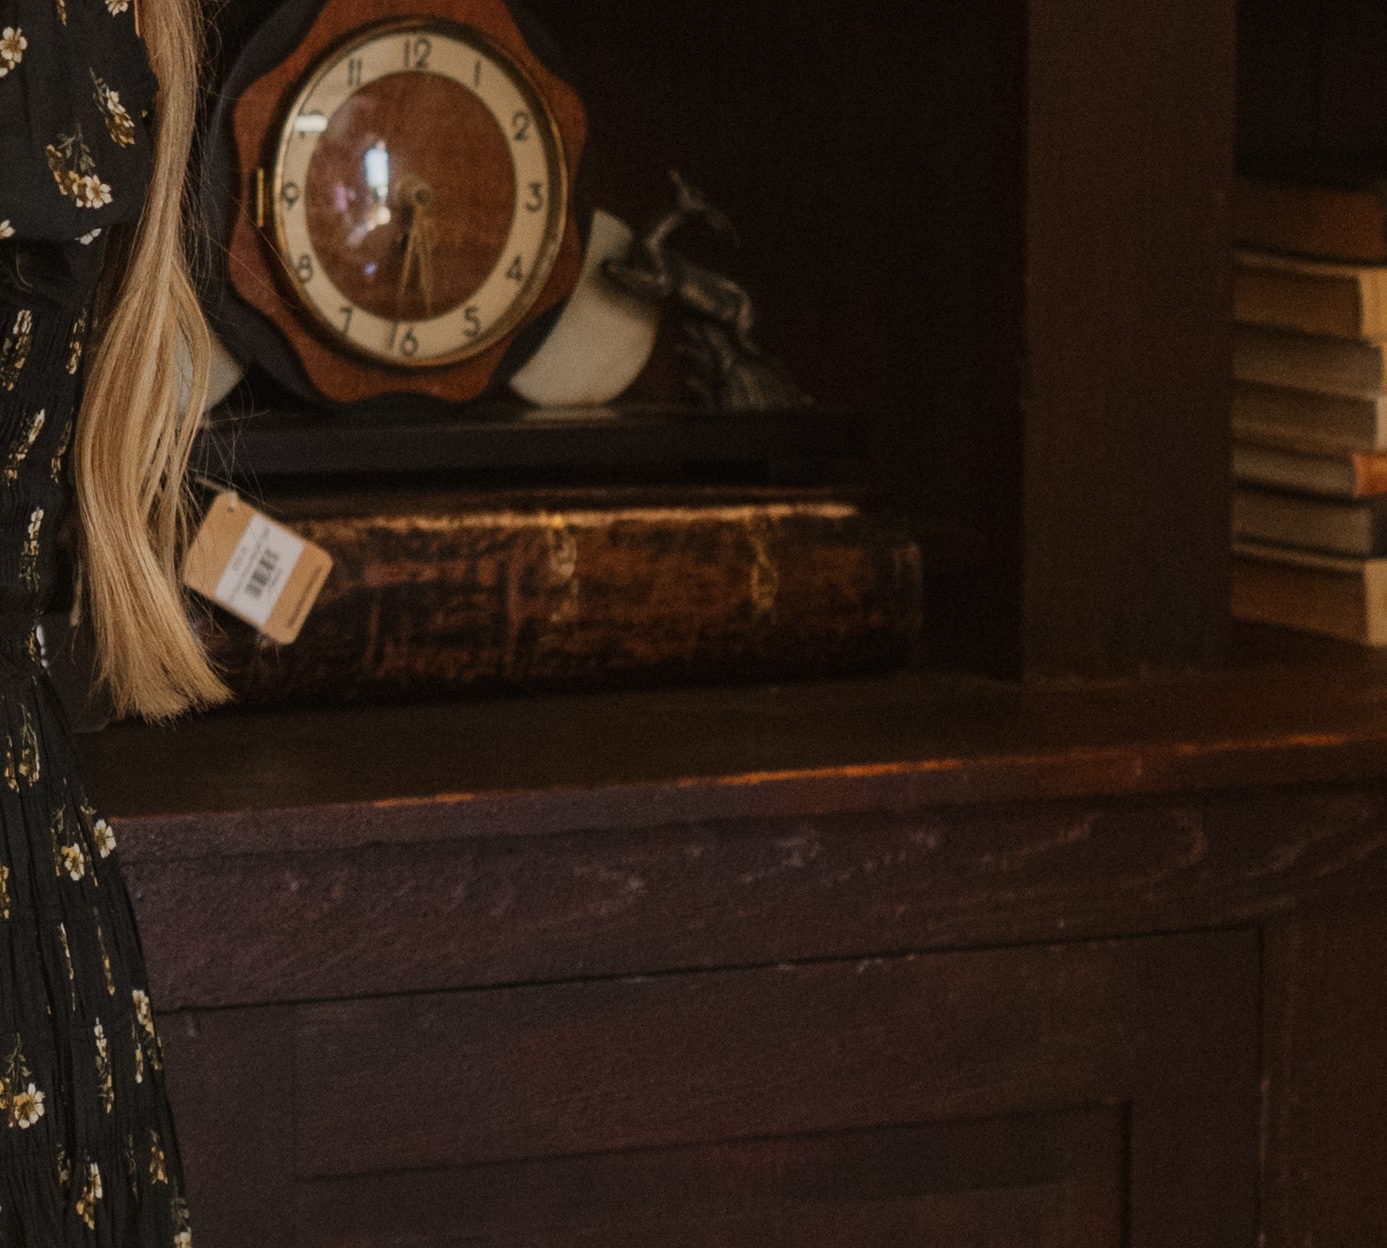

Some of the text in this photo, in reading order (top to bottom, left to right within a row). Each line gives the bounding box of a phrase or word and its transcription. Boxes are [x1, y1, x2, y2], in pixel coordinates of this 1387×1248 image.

[403, 37, 433, 70] 12
[348, 57, 362, 86] 11
[474, 59, 482, 86] 1
[511, 110, 531, 142] 2
[281, 181, 300, 212] 9
[526, 182, 544, 213] 3
[296, 254, 314, 284] 8
[505, 254, 524, 283] 4
[339, 306, 354, 338] 7
[463, 306, 482, 338] 5
